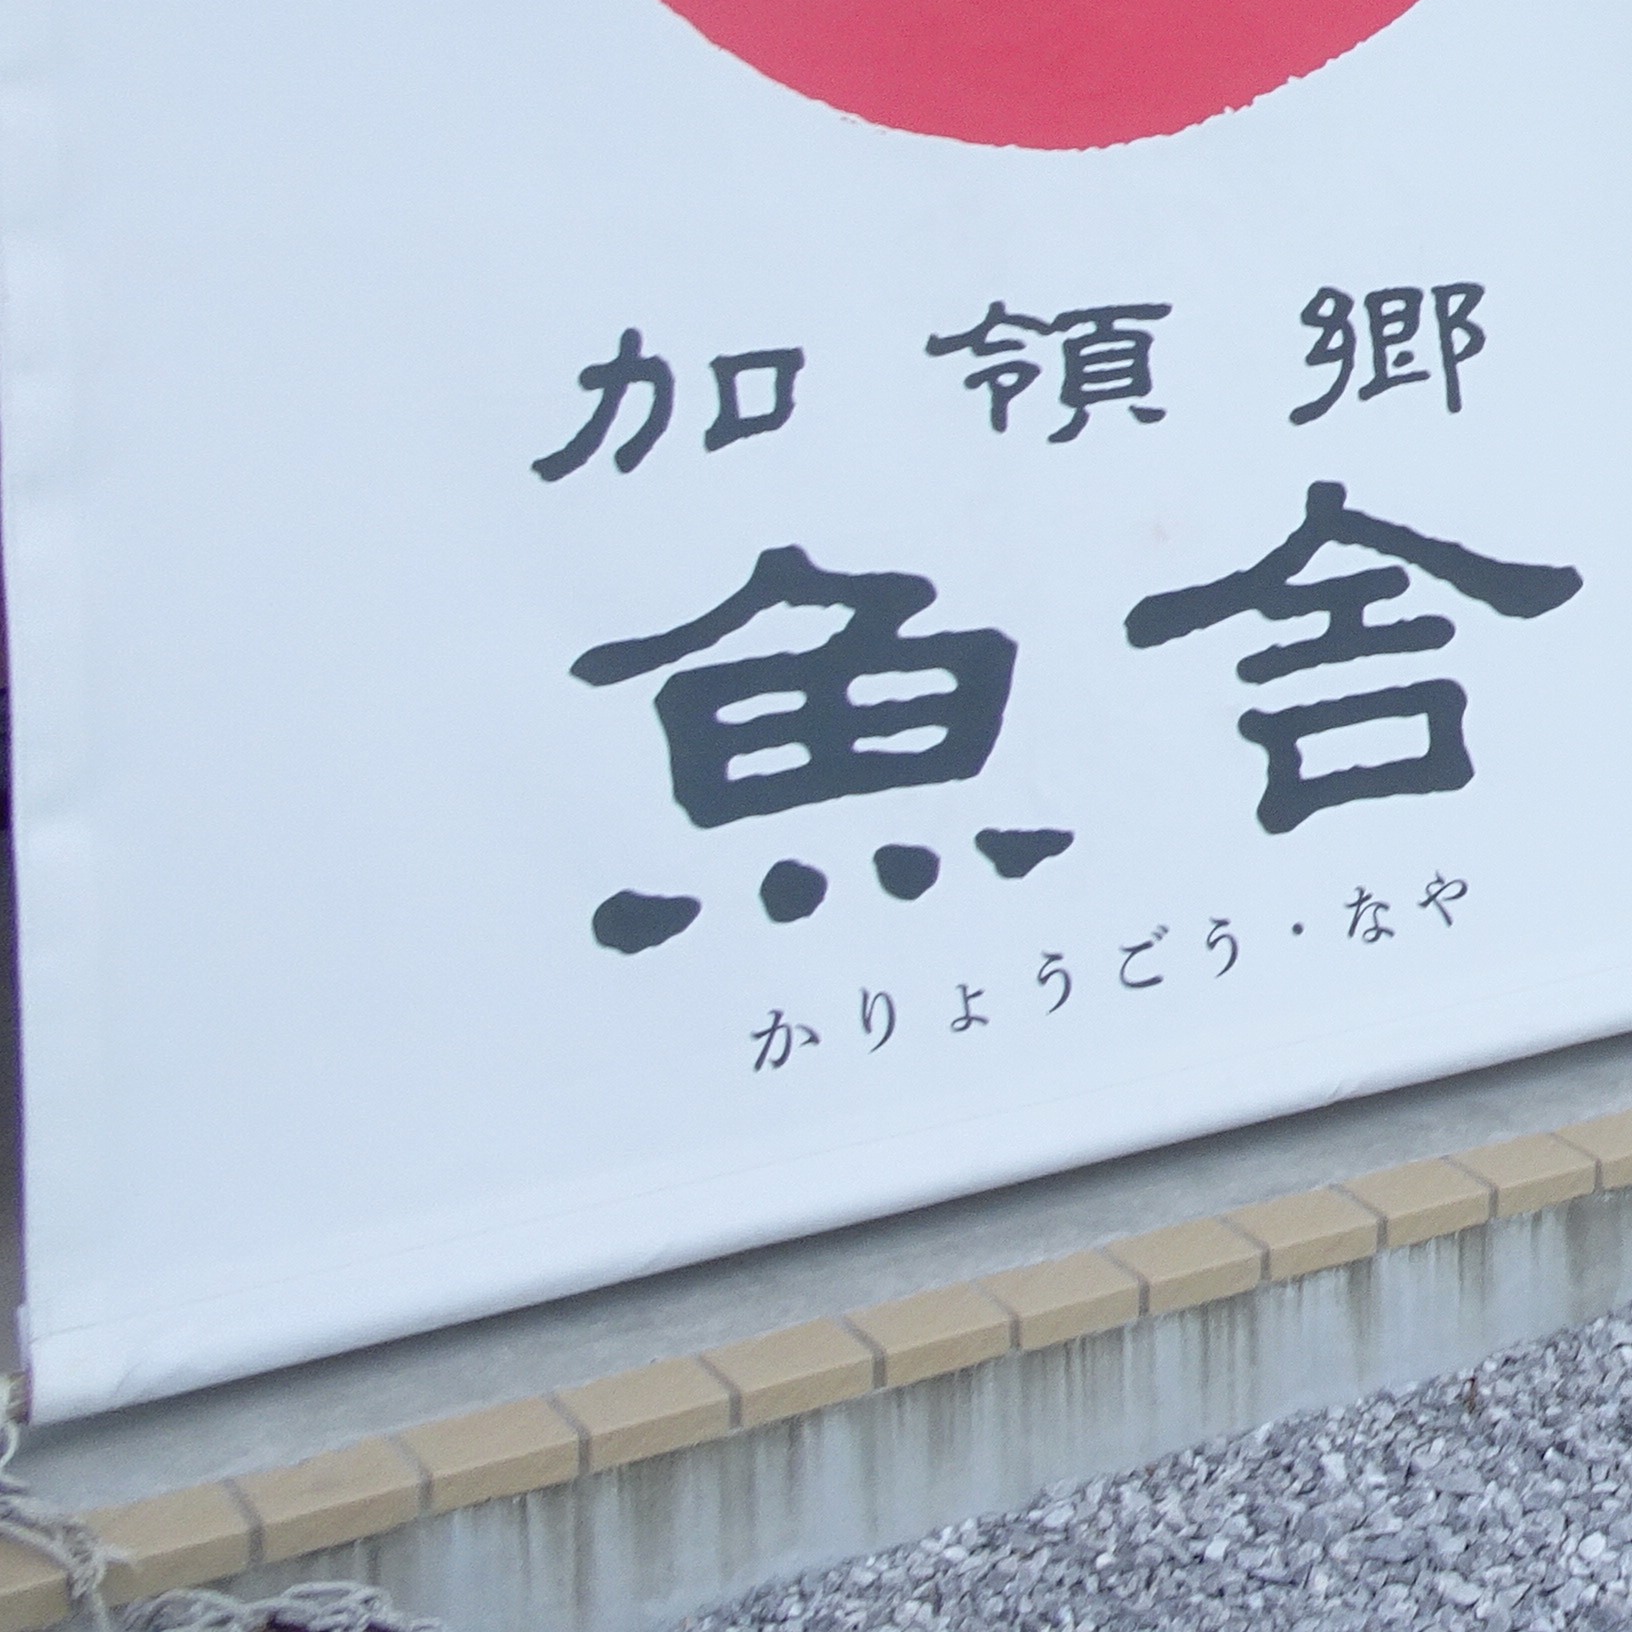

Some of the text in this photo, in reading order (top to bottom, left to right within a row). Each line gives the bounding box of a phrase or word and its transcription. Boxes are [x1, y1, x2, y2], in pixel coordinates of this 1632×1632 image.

[529, 281, 1487, 484] 加領郷
[568, 479, 1584, 957] 魚舎
[750, 870, 1469, 1072] かりょうごう・なや
